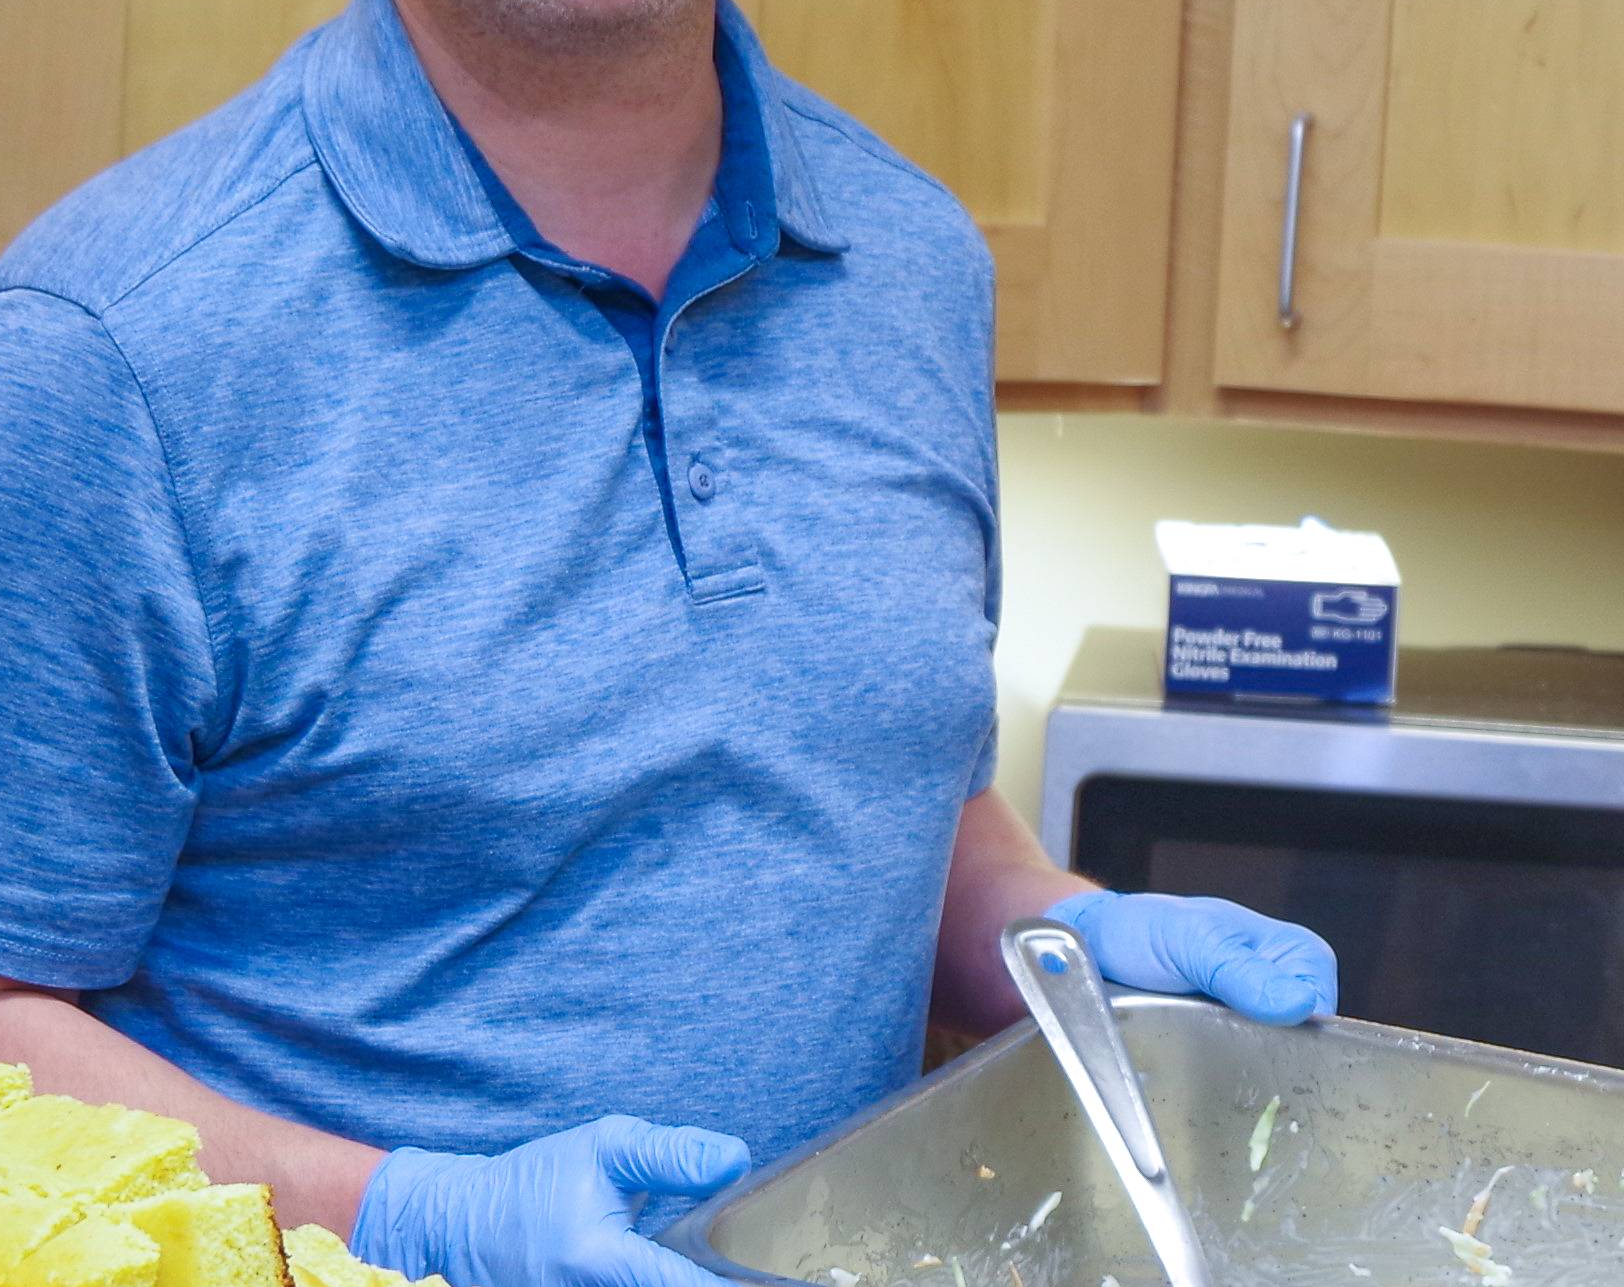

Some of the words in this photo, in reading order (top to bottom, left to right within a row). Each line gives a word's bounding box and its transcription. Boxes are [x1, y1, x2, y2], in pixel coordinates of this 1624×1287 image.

[1172, 626, 1240, 648] Powder
[1243, 630, 1284, 649] Free
[1172, 643, 1227, 662] Nitrile
[1229, 648, 1340, 671] Examination
[1170, 663, 1230, 682] Gloves
